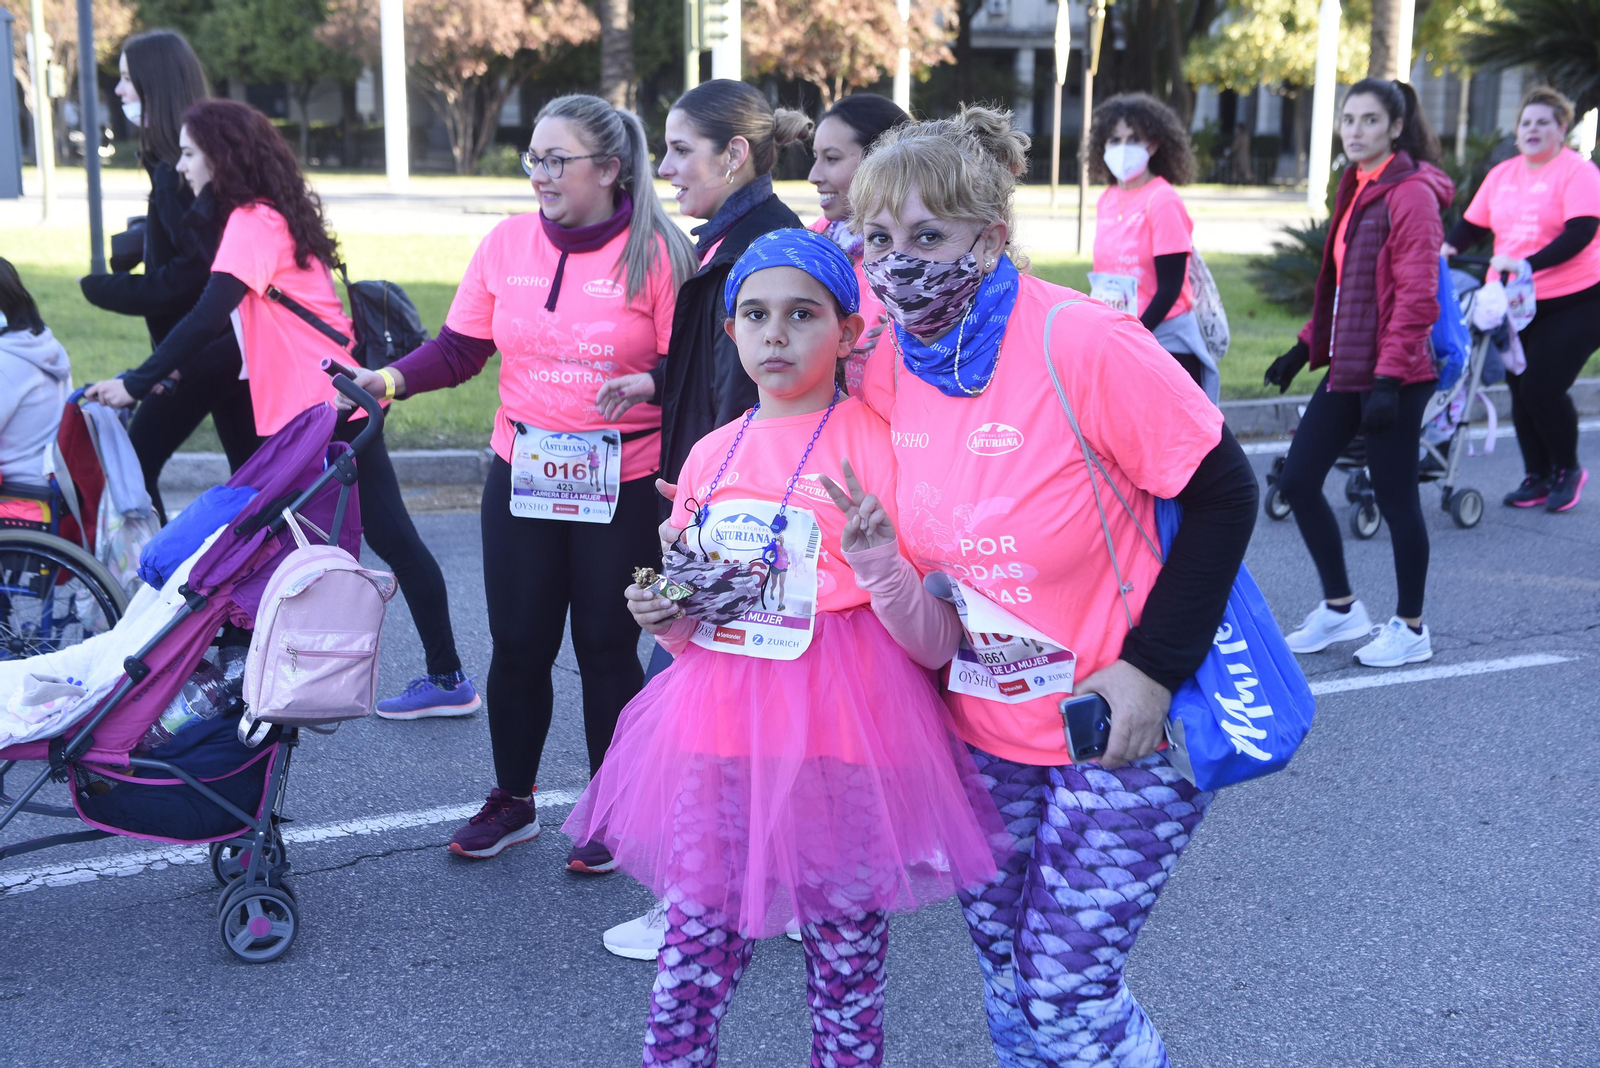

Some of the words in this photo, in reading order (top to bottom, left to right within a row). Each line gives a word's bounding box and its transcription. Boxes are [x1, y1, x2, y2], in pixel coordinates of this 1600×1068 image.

[506, 275, 550, 289] OYSHO
[578, 342, 615, 357] POR
[543, 440, 587, 453] ASTURIANA
[970, 436, 1019, 449] ASTURIANA
[543, 461, 587, 481] 016
[556, 483, 574, 492] 423
[793, 480, 833, 500] ASTURIA
[532, 490, 560, 499] CARRERA
[560, 491, 570, 499] DE
[570, 492, 580, 500] LA
[579, 493, 602, 501] MUJER
[514, 501, 549, 512] OYSHO
[715, 528, 771, 545] ASTURIANA
[959, 535, 1018, 557] POR
[747, 612, 783, 626] MUJER
[720, 632, 742, 641] Santander
[767, 637, 800, 648] ZURICH
[993, 665, 1003, 675] DE
[1004, 664, 1017, 674] LA
[1018, 656, 1049, 670] MUJER
